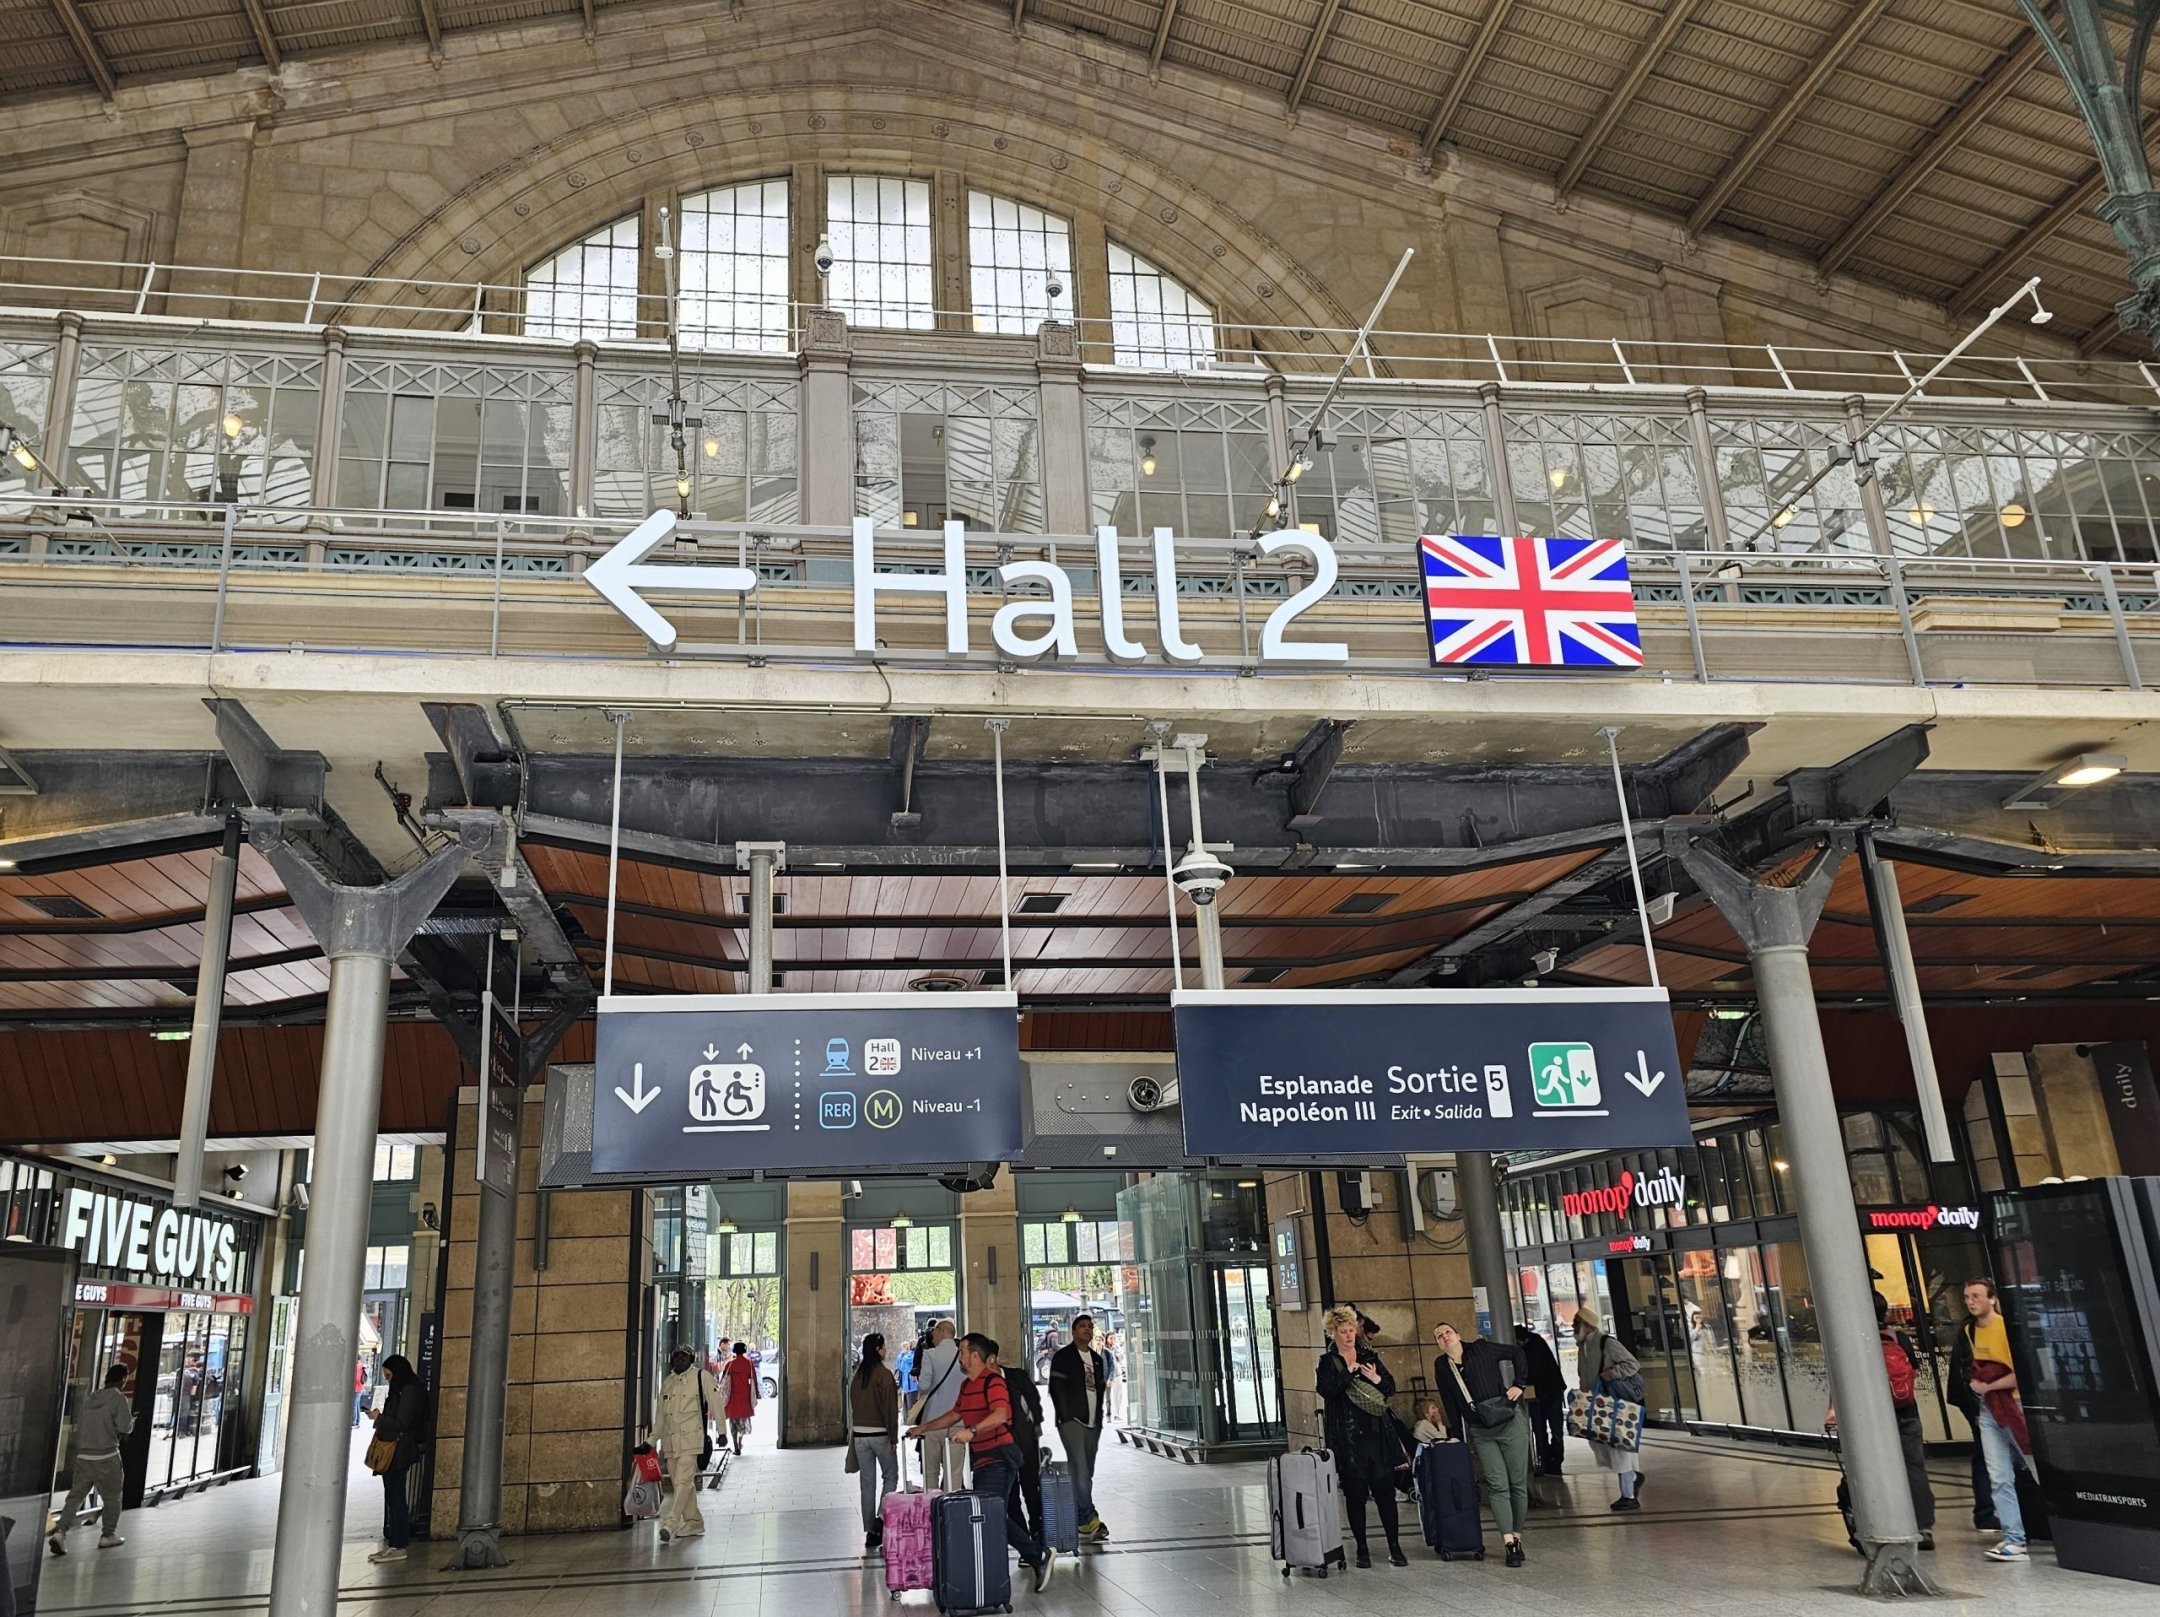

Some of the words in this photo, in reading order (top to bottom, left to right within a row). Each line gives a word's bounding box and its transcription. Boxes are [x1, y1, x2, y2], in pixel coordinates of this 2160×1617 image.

[853, 516, 1205, 664] Hall
[1257, 528, 1349, 663] 2
[870, 1042, 896, 1053] Hall
[911, 1046, 961, 1061] Niveau
[964, 1046, 983, 1060] +1
[868, 1057, 879, 1071] 2
[1260, 1074, 1373, 1099] Esplanade
[1387, 1066, 1478, 1095] Sortie
[1488, 1070, 1504, 1092] 5
[2115, 1063, 2137, 1109] daily
[824, 1103, 852, 1118] RER
[873, 1098, 894, 1119] M
[912, 1099, 962, 1114] Niveau
[966, 1098, 982, 1112] -1
[1240, 1101, 1348, 1127] Napoléon
[1354, 1101, 1376, 1121] III
[1390, 1106, 1421, 1120] Exit
[1434, 1105, 1483, 1120] Salida
[65, 1188, 153, 1271] FIVE
[154, 1208, 235, 1283] GUYS
[83, 1285, 107, 1302] GUYS
[181, 1293, 195, 1308] FIVE
[196, 1294, 212, 1309] GUYS
[2075, 1491, 2147, 1508] MEDIATRANSPORTS
